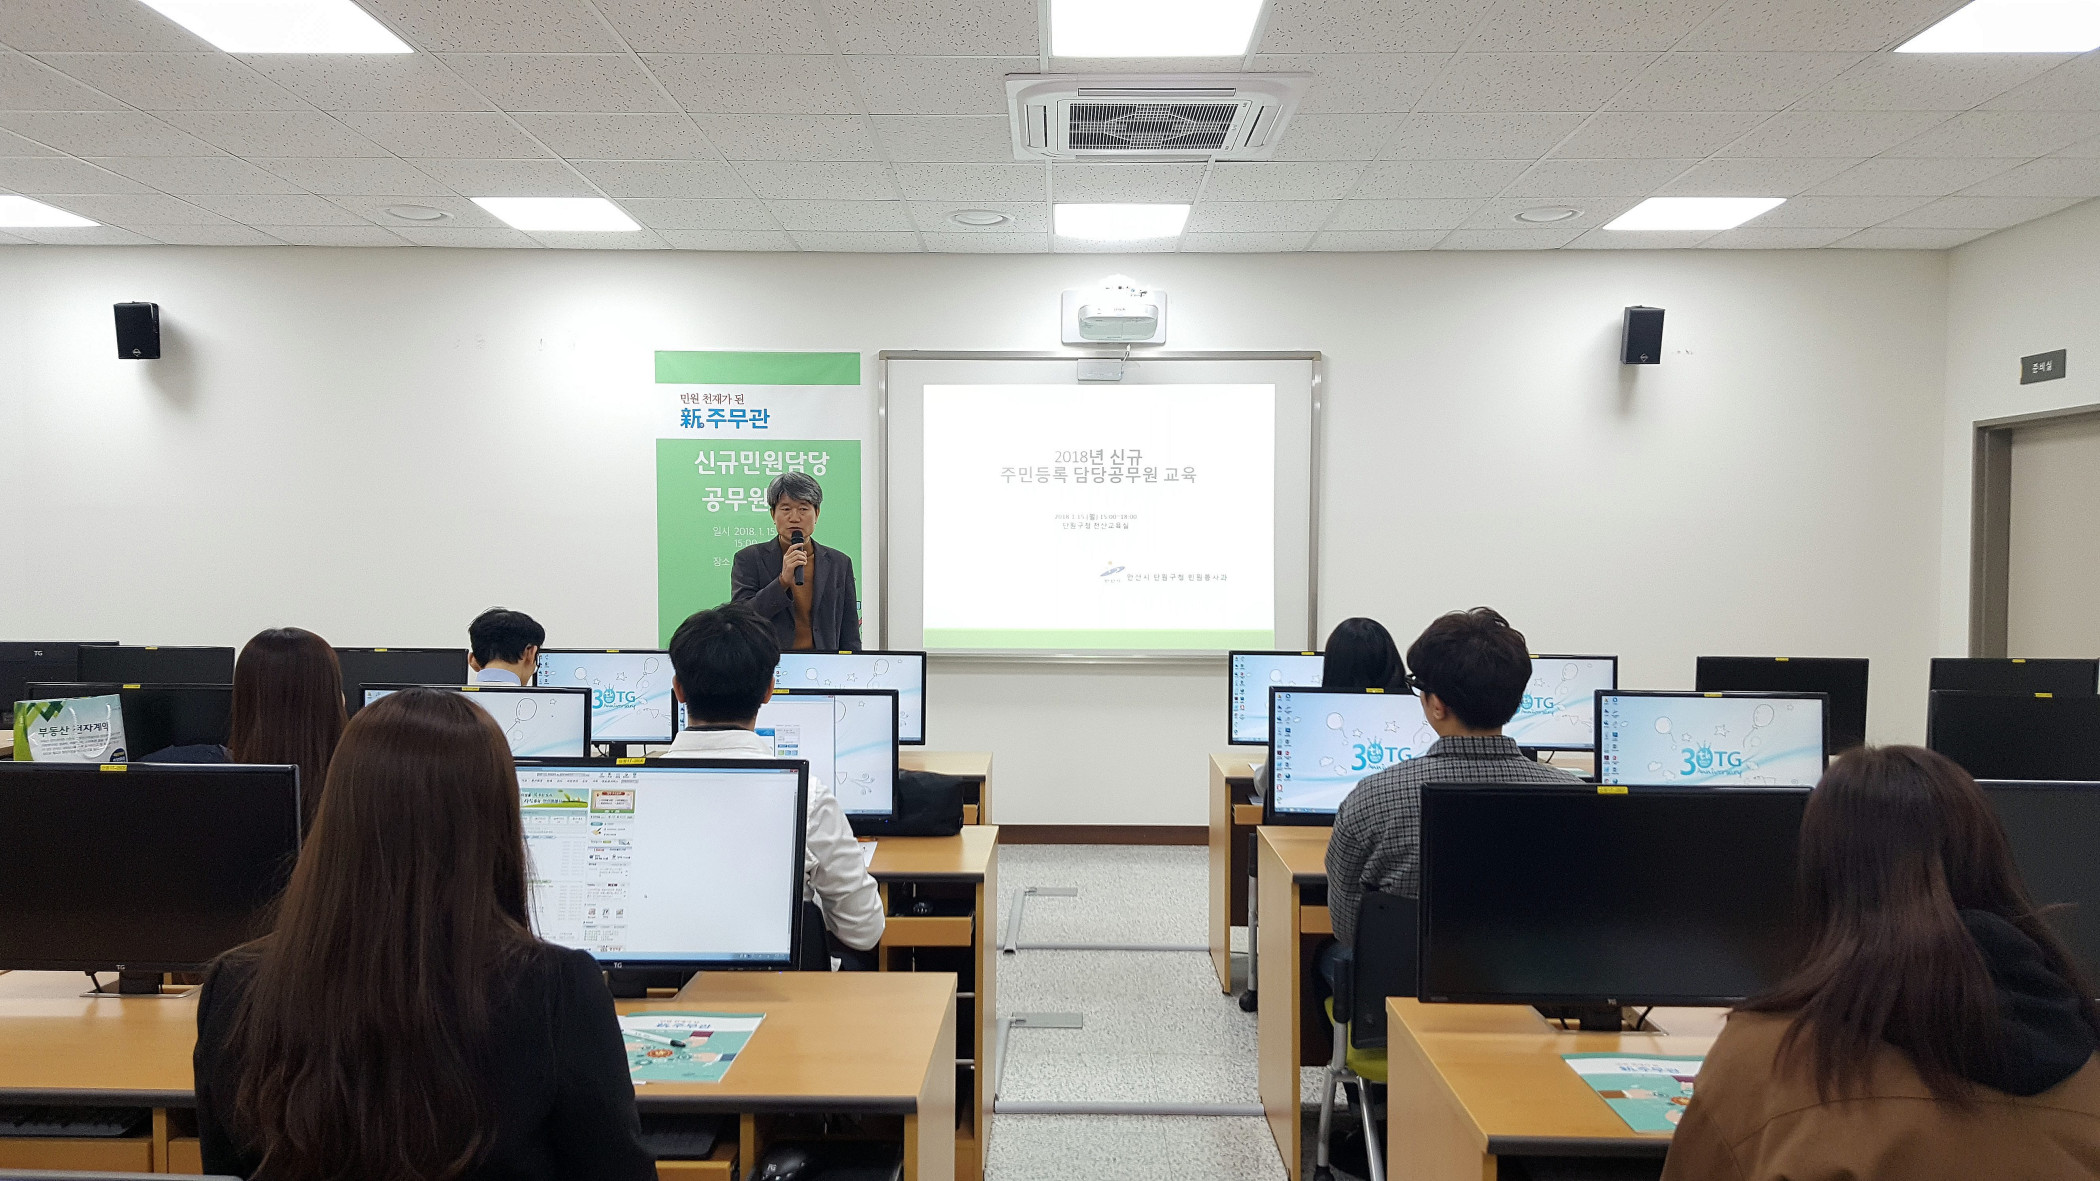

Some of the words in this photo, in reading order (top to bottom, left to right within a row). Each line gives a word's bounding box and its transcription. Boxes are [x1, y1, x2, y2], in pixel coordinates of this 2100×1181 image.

[680, 392, 700, 404] 민원
[702, 393, 732, 405] 천재가
[734, 393, 744, 404] 된
[694, 450, 830, 476] 신규민원담당
[1054, 449, 1104, 465] 2018년
[1110, 449, 1143, 466] 신규
[1000, 466, 1069, 483] 주민등록
[1073, 466, 1158, 484] 담당공무원
[1164, 466, 1197, 483] 교육
[702, 487, 768, 512] 공무원
[713, 526, 730, 537] 일시
[713, 556, 731, 567] 장소
[616, 691, 636, 703] TG
[1534, 697, 1554, 709] TG
[38, 725, 70, 737] 부동산
[1385, 747, 1412, 763] TG
[1714, 751, 1741, 767] TG
[1697, 767, 1742, 778] Anniversary
[614, 961, 623, 969] TG
